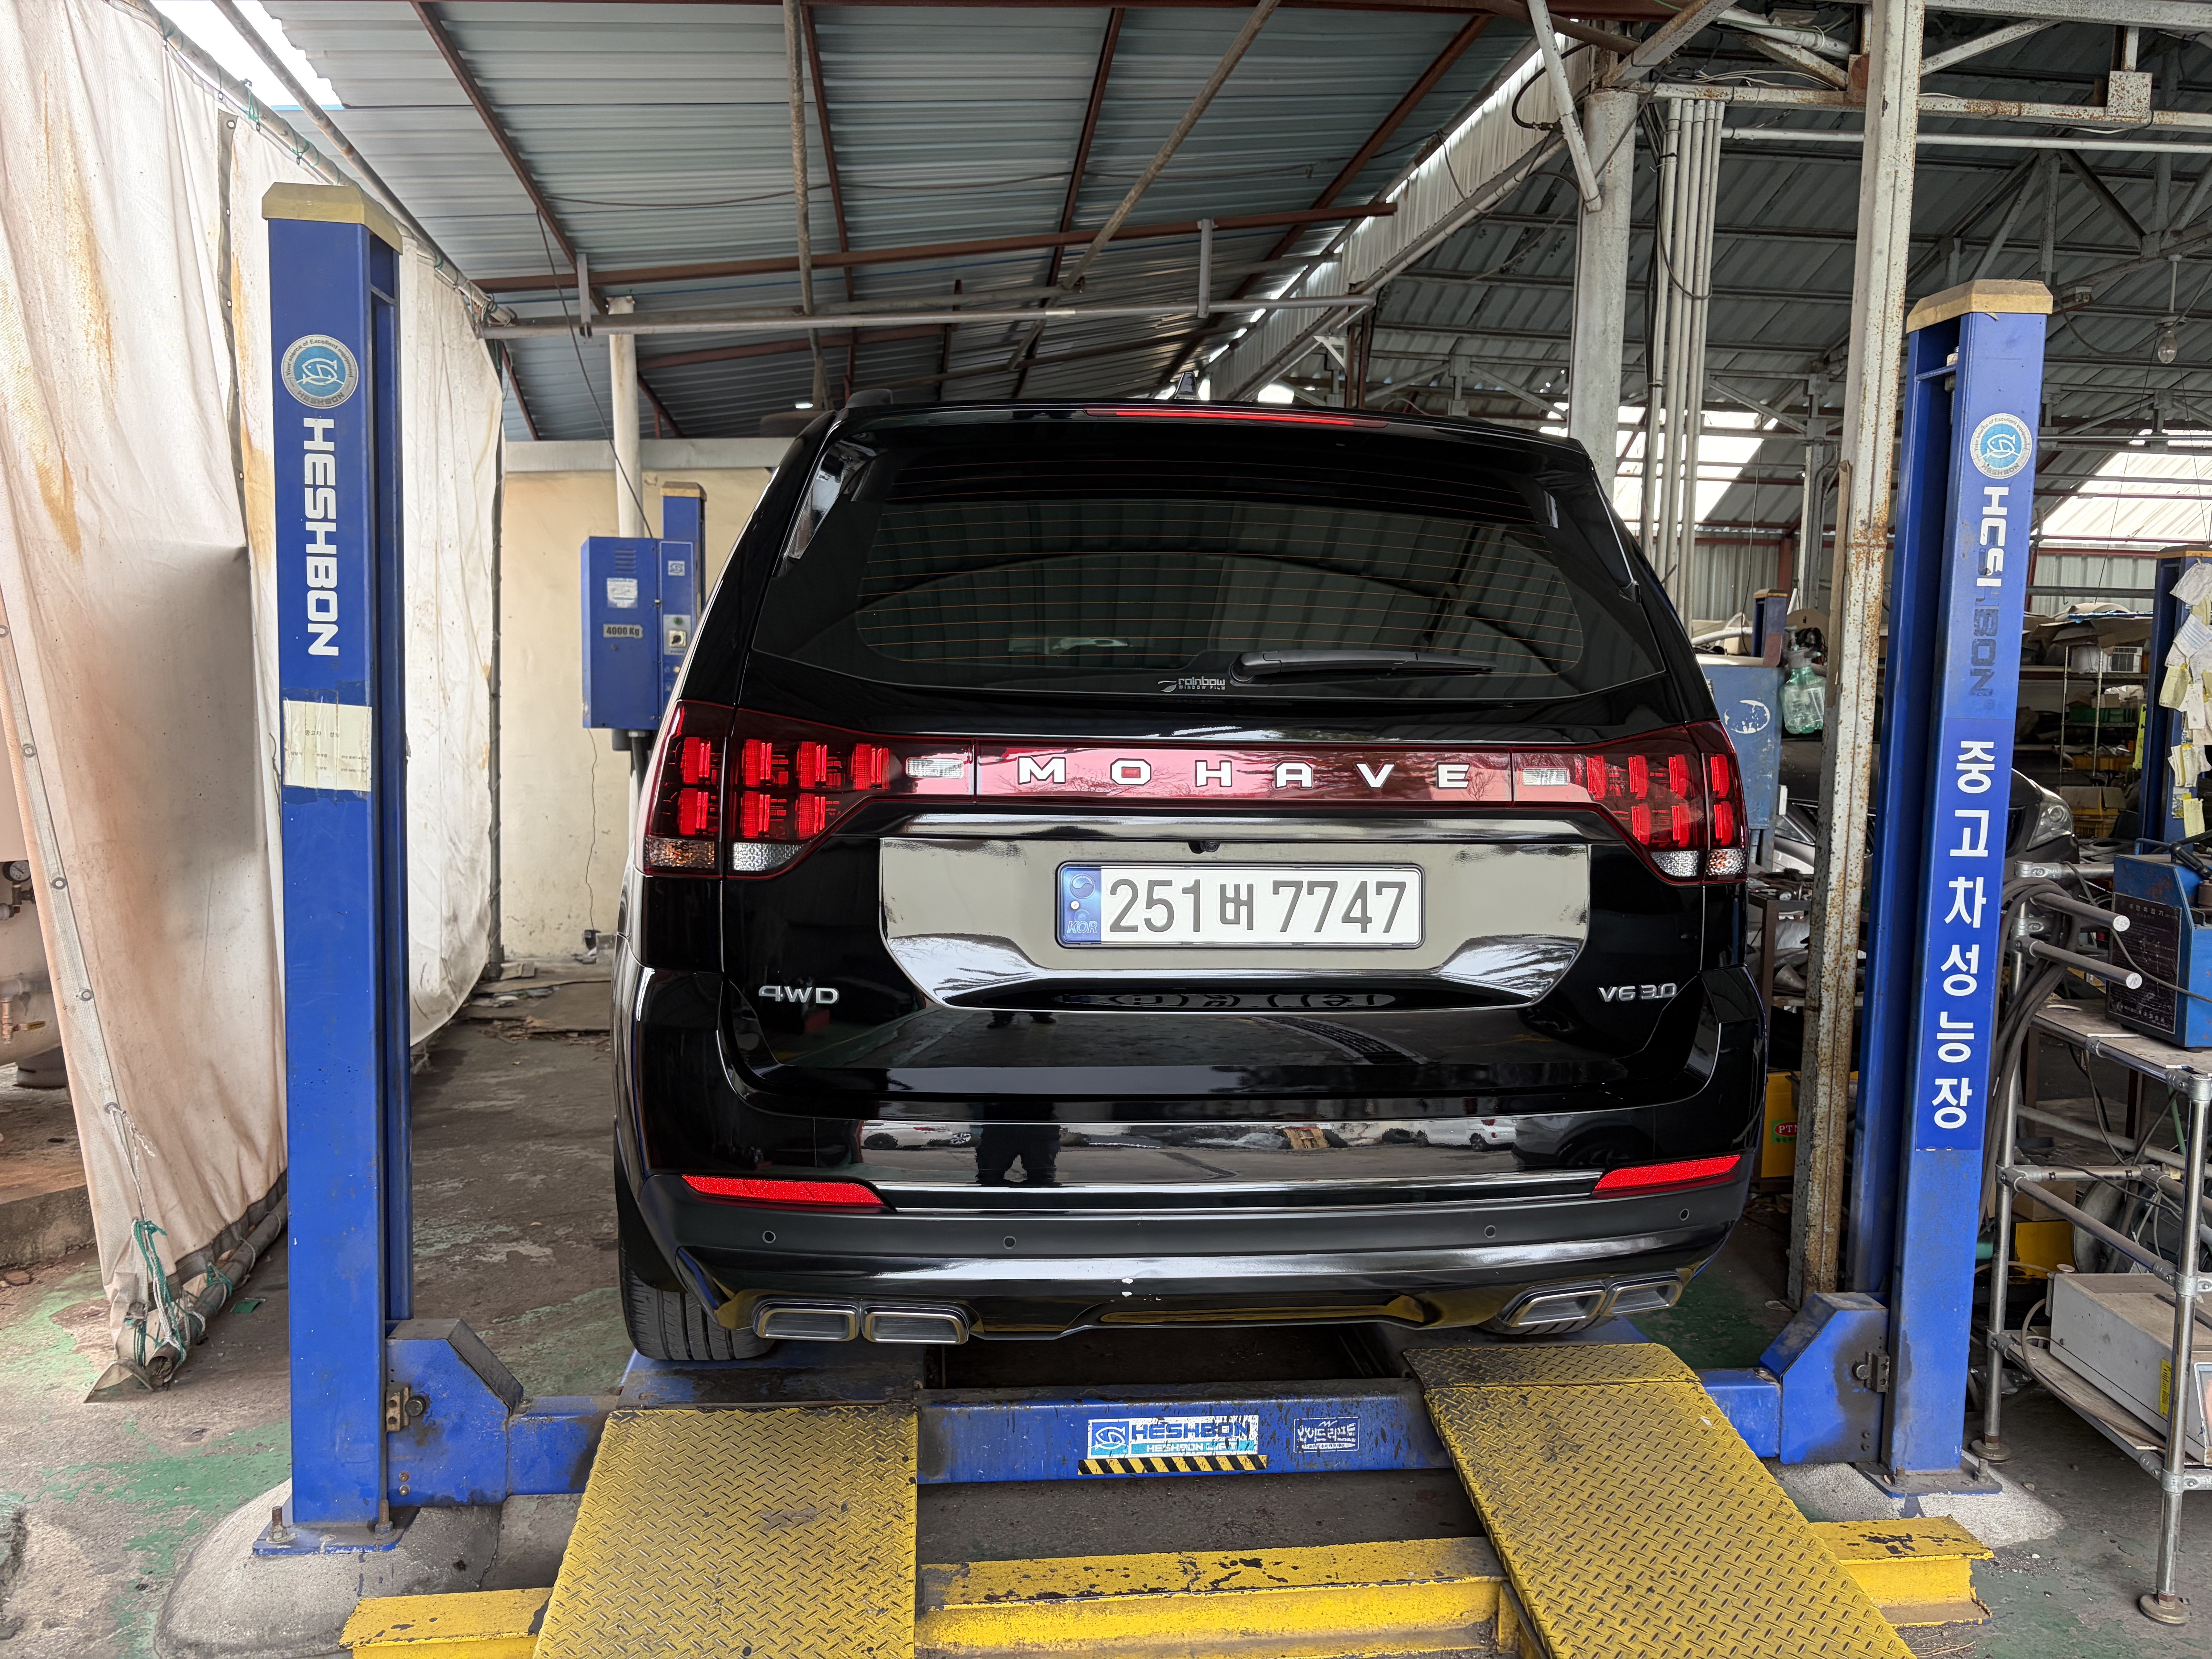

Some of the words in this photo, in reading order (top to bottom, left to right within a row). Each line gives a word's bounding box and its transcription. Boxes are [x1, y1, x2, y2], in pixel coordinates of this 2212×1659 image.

[303, 417, 339, 656] HESHBON
[607, 627, 627, 635] 4000
[629, 627, 639, 636] Kg
[1178, 676, 1225, 685] rainbow
[1017, 756, 1470, 788] MOHAVE
[1109, 878, 1254, 932] 251버
[1273, 880, 1406, 933] 7747
[1066, 920, 1098, 934] KOR
[759, 986, 839, 1004] 4WD
[1597, 986, 1636, 1002] V6
[1131, 1422, 1250, 1440] HESHBON
[1146, 1442, 1201, 1452] HESHBON
[1206, 1441, 1236, 1451] LIFT
